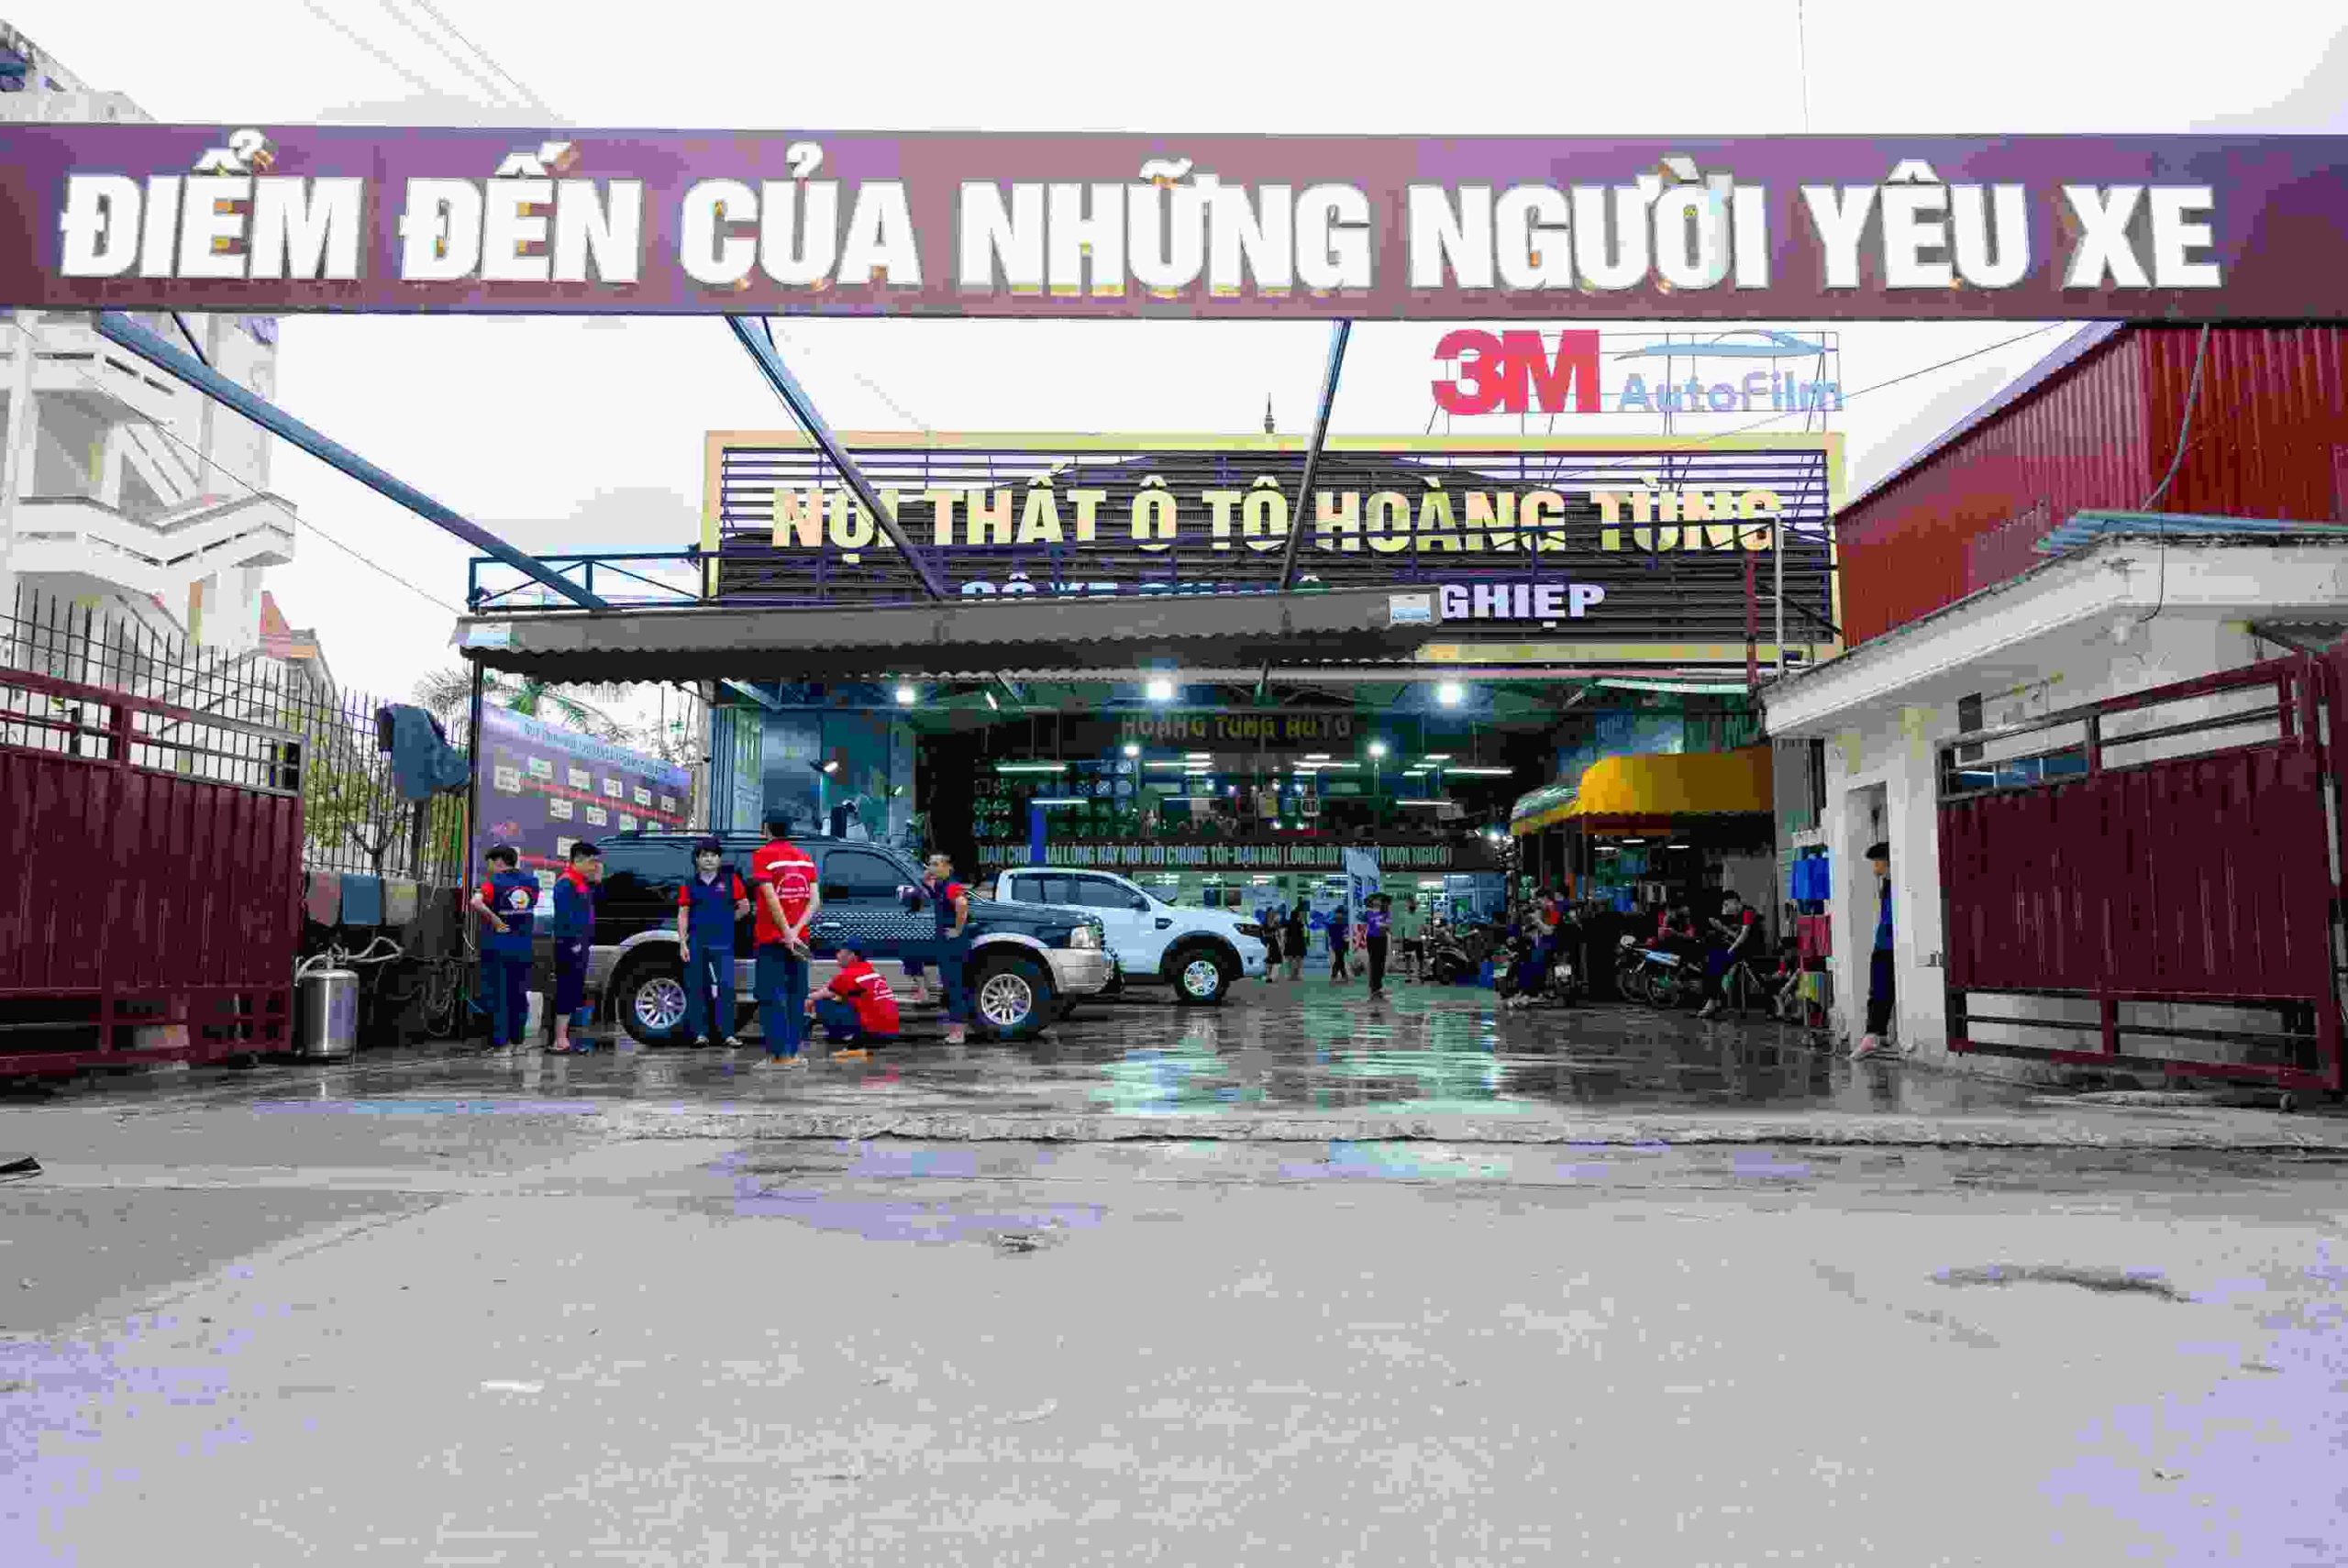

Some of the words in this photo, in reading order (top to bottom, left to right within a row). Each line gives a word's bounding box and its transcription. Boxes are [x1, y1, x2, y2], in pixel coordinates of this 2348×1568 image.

[59, 127, 365, 281] ĐIỂM
[398, 139, 643, 283] ĐẾN
[679, 141, 923, 290] CỦA
[959, 157, 1373, 293] NHỮNG
[1405, 155, 1770, 291] NGƯỜI
[1800, 159, 2029, 291] YÊU
[2062, 185, 2222, 290] XE
[1431, 329, 1601, 415] 3M
[1617, 370, 1844, 413] AutoFilm
[924, 462, 1107, 546] THẤT
[1131, 475, 1177, 551] Ô
[1202, 475, 1289, 551] TÔ
[1314, 476, 1566, 552] HOÀNG
[1439, 580, 1606, 629] GHIỆP
